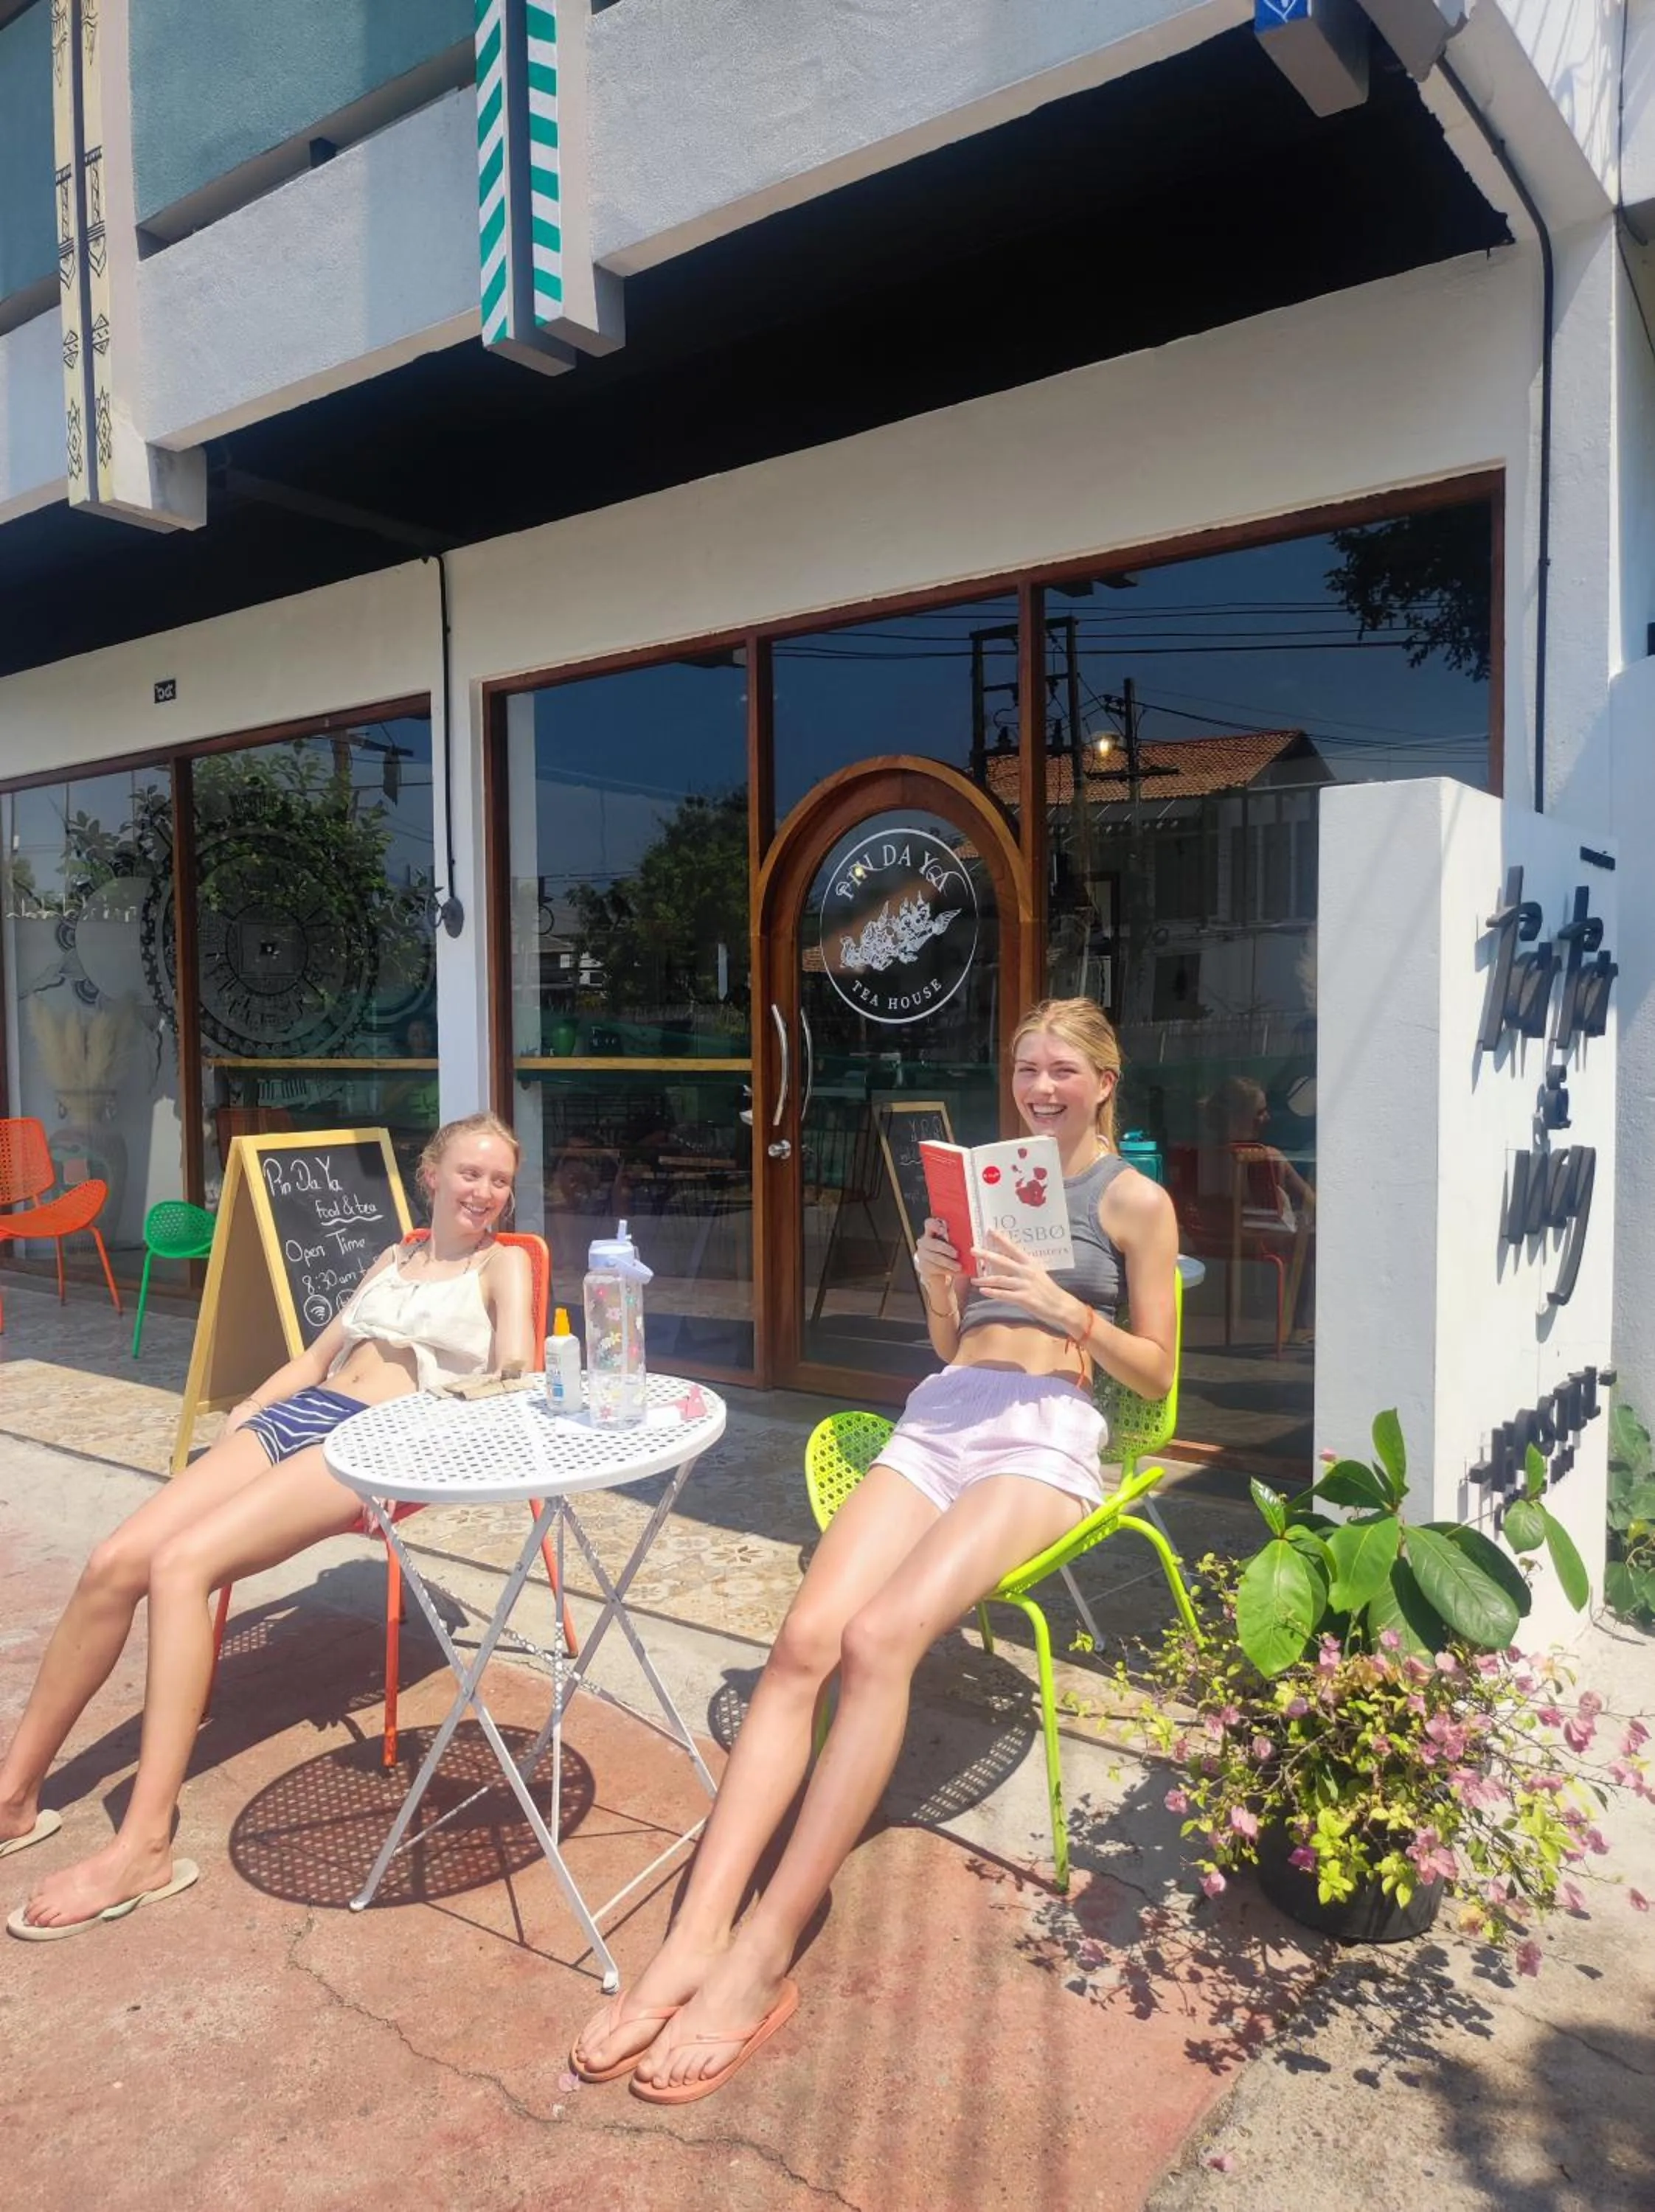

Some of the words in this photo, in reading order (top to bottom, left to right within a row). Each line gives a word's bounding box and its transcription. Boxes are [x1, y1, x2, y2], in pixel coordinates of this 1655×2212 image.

[883, 844, 912, 867] DA
[852, 979, 879, 1007] TEA
[887, 978, 943, 1009] HOUSE
[263, 1158, 291, 1197] Pin
[290, 1159, 321, 1192] Da
[315, 1155, 343, 1192] Ya
[285, 1239, 325, 1267] Open
[325, 1228, 366, 1256] Time
